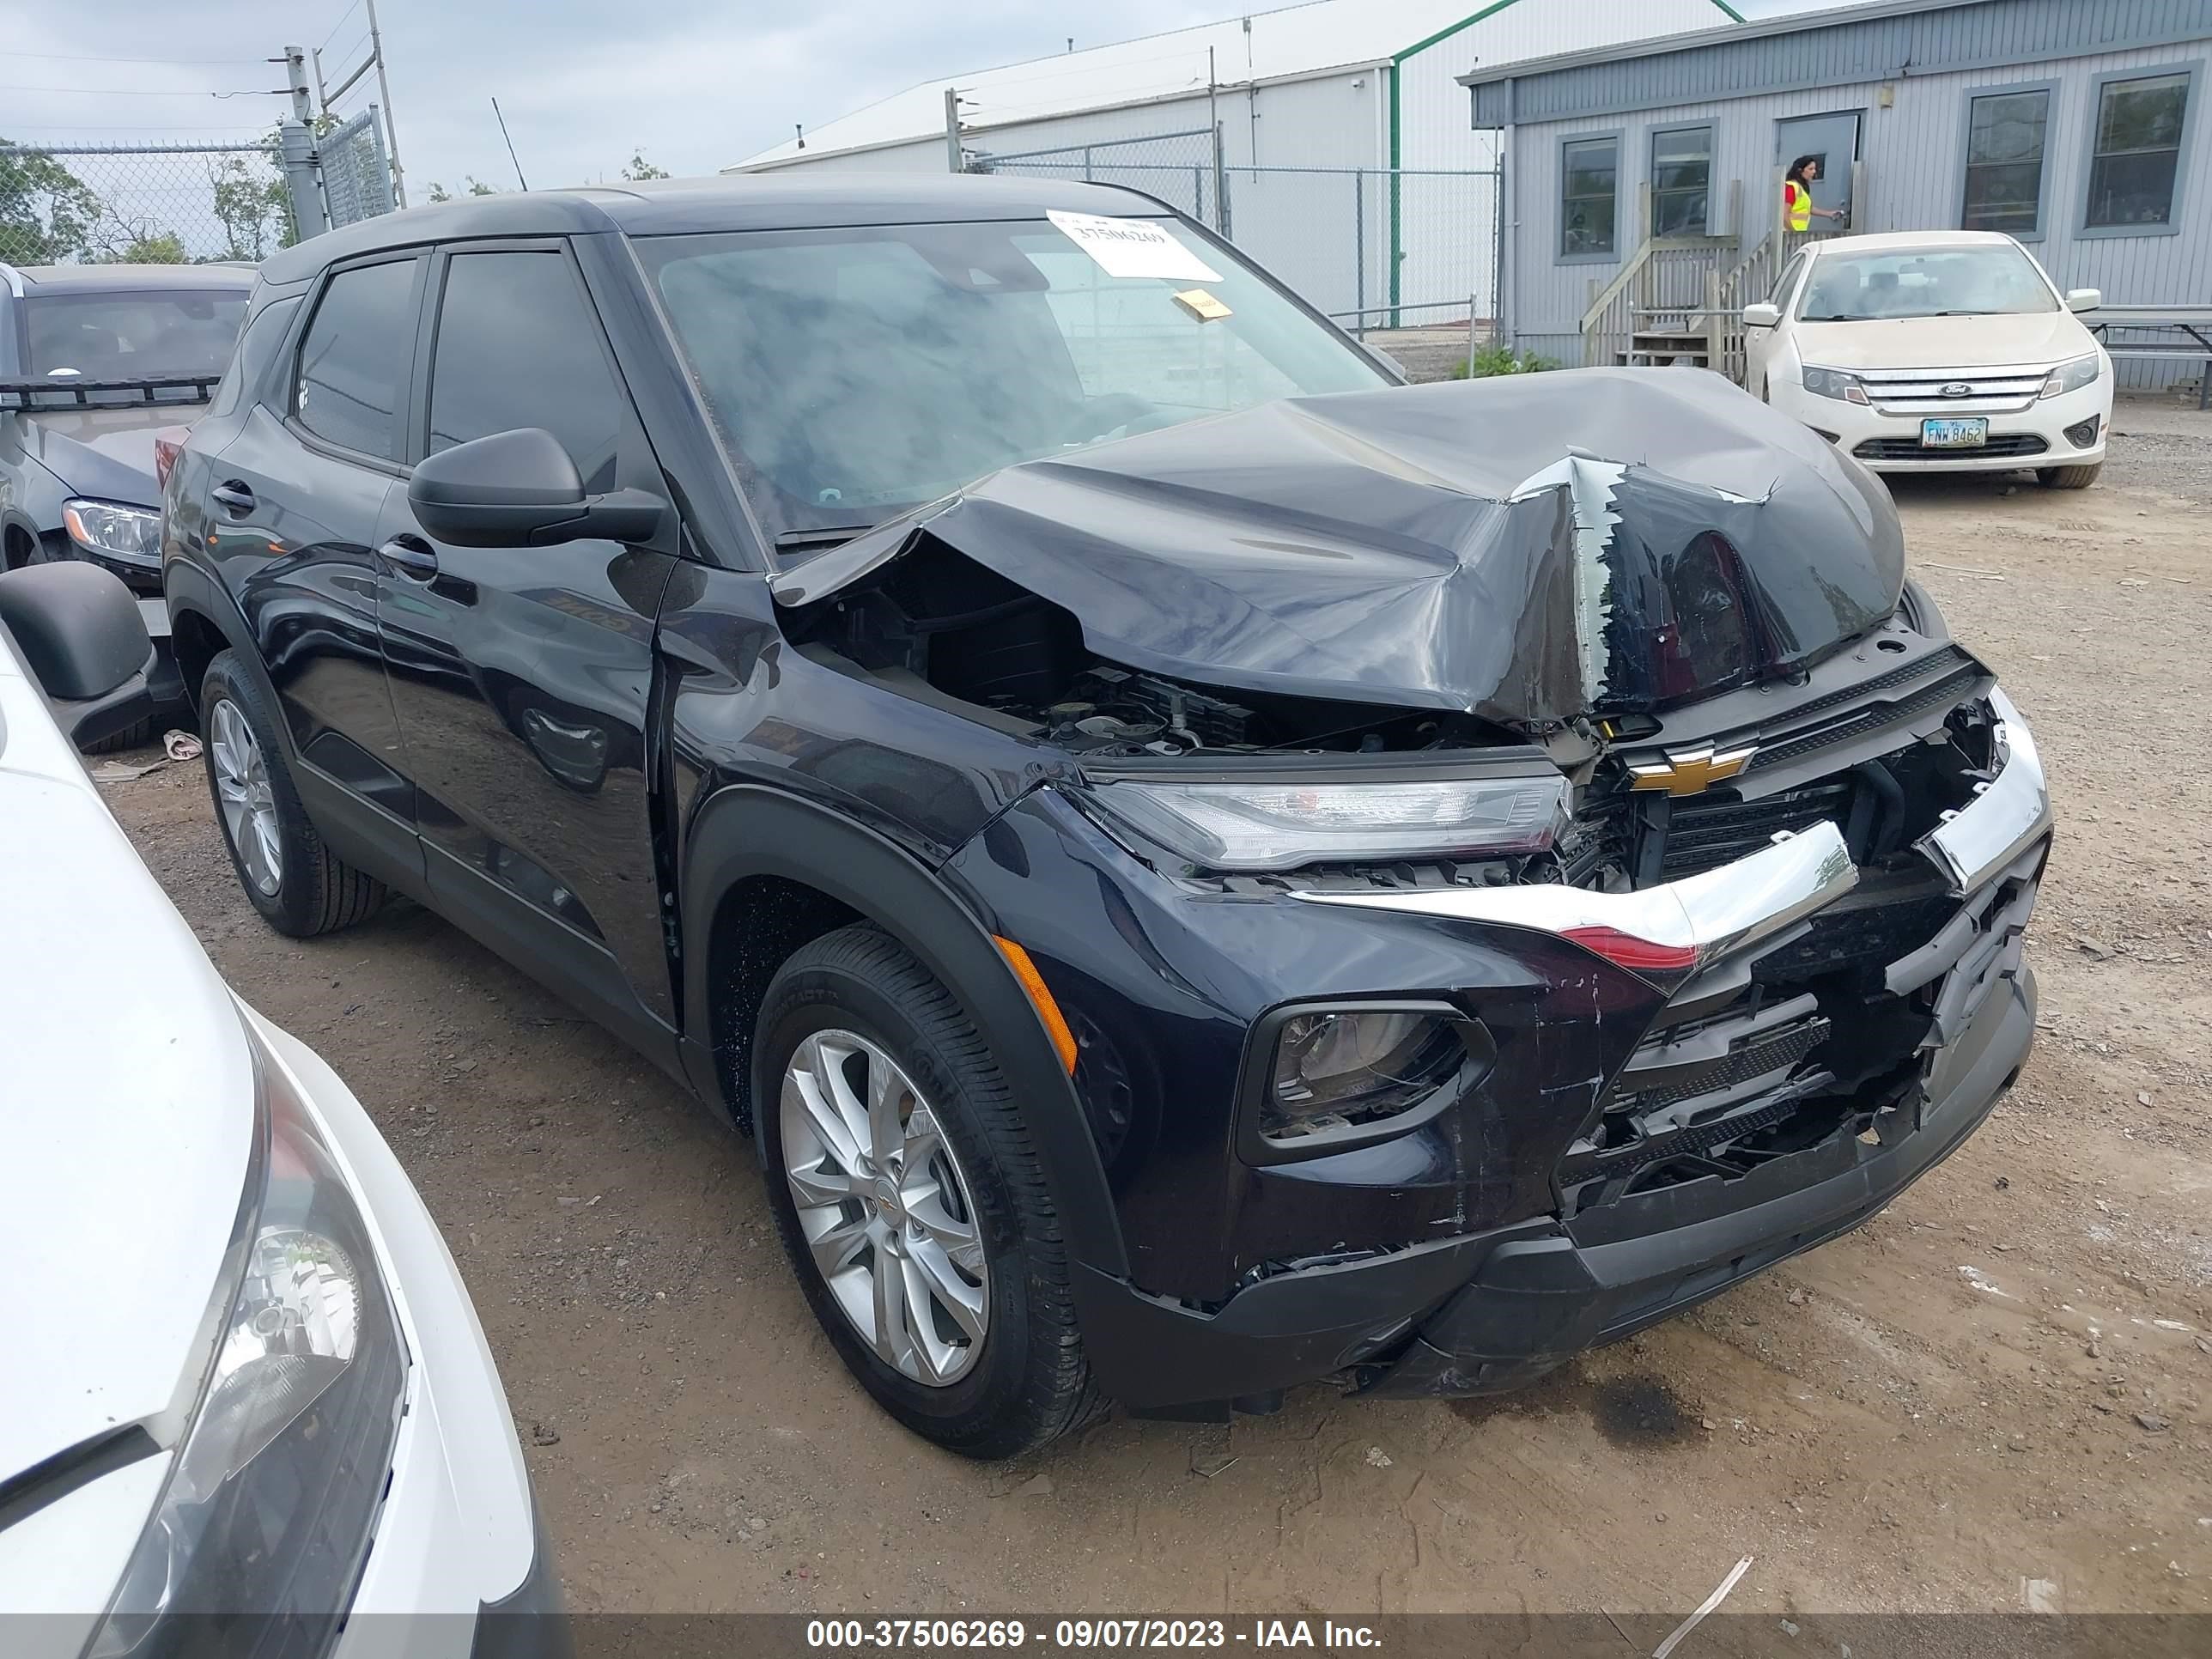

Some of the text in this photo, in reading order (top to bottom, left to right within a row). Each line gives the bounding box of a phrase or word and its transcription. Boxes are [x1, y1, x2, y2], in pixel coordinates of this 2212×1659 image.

[1073, 227, 1165, 244] 37506269
[1945, 383, 1967, 394] Ford
[1928, 427, 1981, 442] FNW 8462
